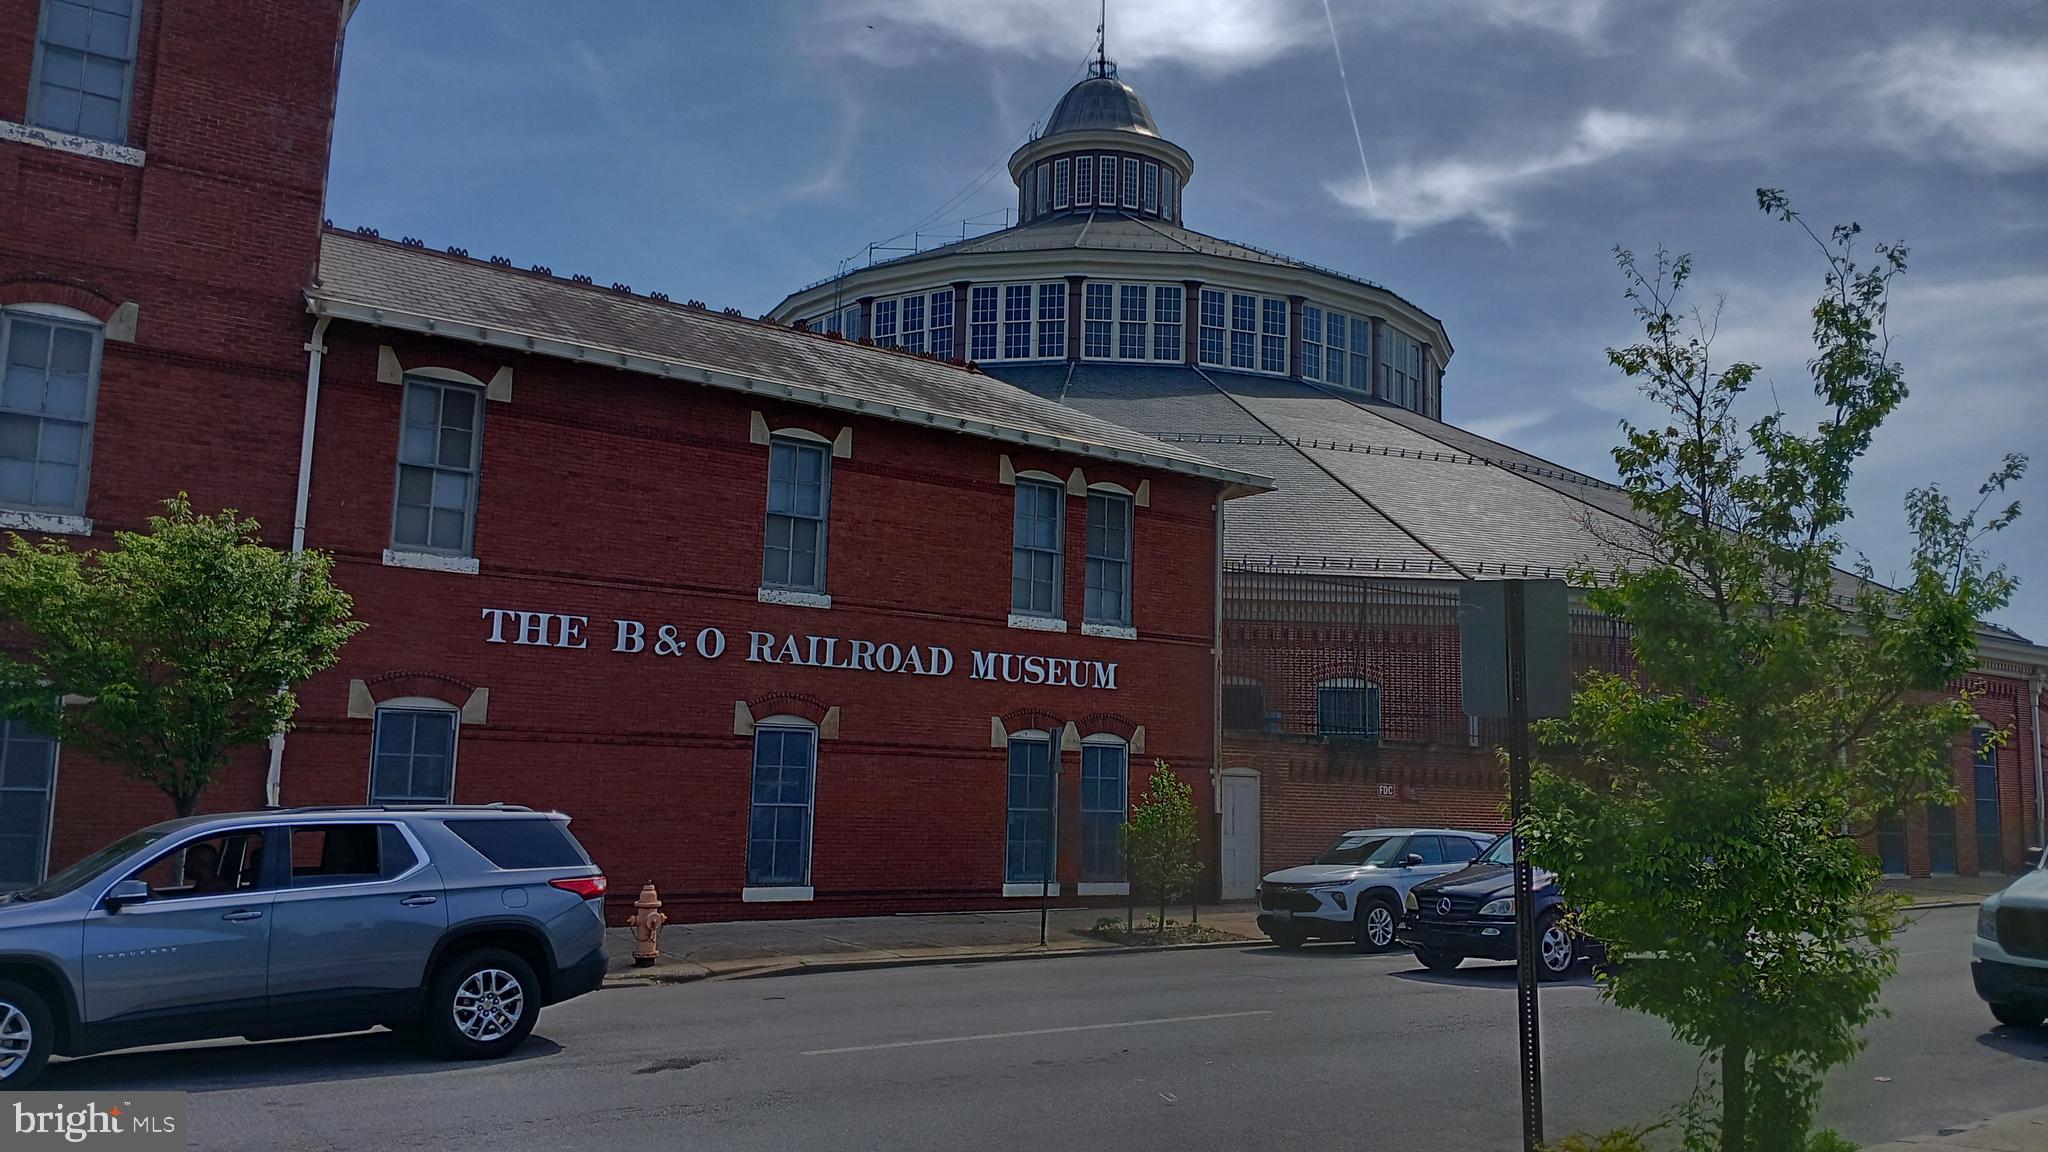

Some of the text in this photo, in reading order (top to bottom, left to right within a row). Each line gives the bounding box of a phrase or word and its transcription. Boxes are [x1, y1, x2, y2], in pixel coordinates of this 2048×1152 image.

[482, 607, 589, 649] THE
[745, 631, 954, 677] RAILROAD
[969, 650, 1119, 690] MUSEUM
[1379, 785, 1394, 795] FDC
